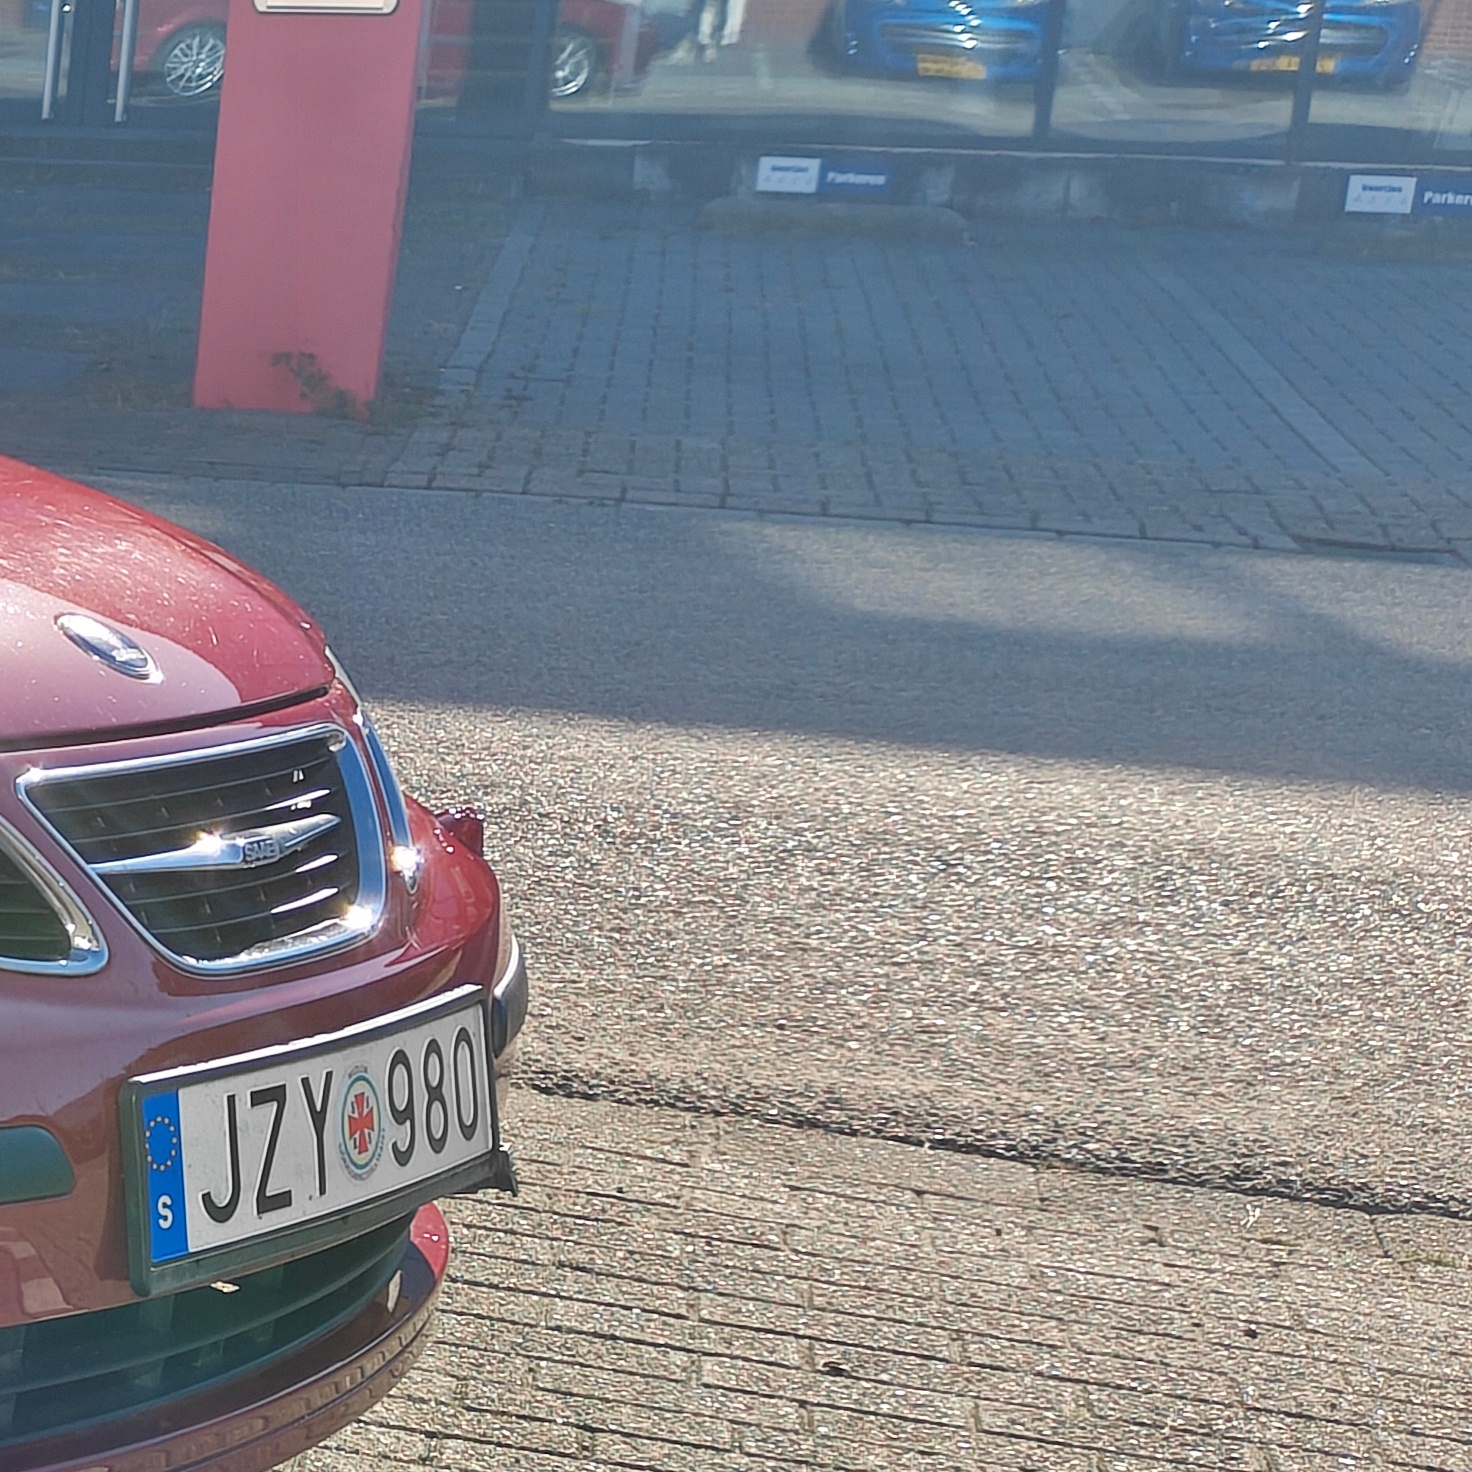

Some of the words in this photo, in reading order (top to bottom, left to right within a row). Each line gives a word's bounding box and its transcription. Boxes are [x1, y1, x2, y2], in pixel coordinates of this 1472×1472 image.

[200, 1069, 334, 1225] JZY
[386, 1025, 479, 1168] 980
[157, 1194, 175, 1230] S
